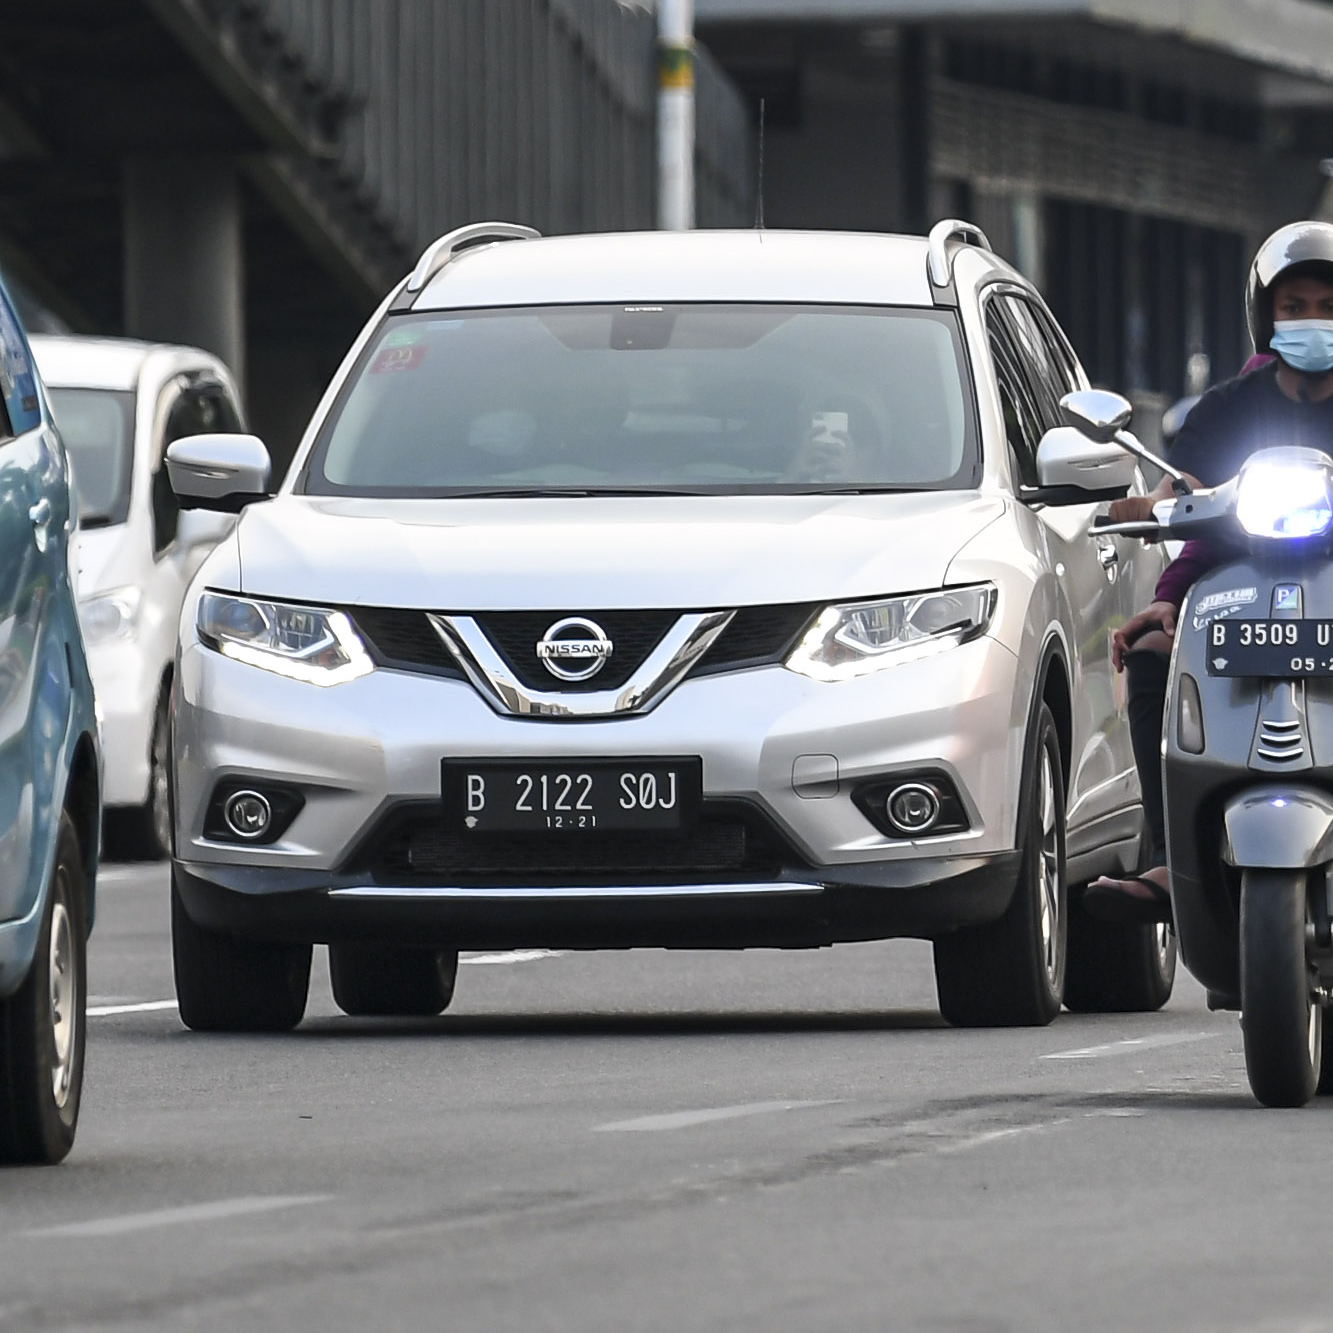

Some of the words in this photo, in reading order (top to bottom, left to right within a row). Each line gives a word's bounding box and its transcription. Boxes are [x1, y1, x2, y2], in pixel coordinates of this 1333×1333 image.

[1213, 623, 1226, 646] B
[1240, 623, 1298, 646] 3509
[544, 644, 605, 654] NISSAN
[467, 774, 485, 812] B
[515, 774, 593, 811] 2122
